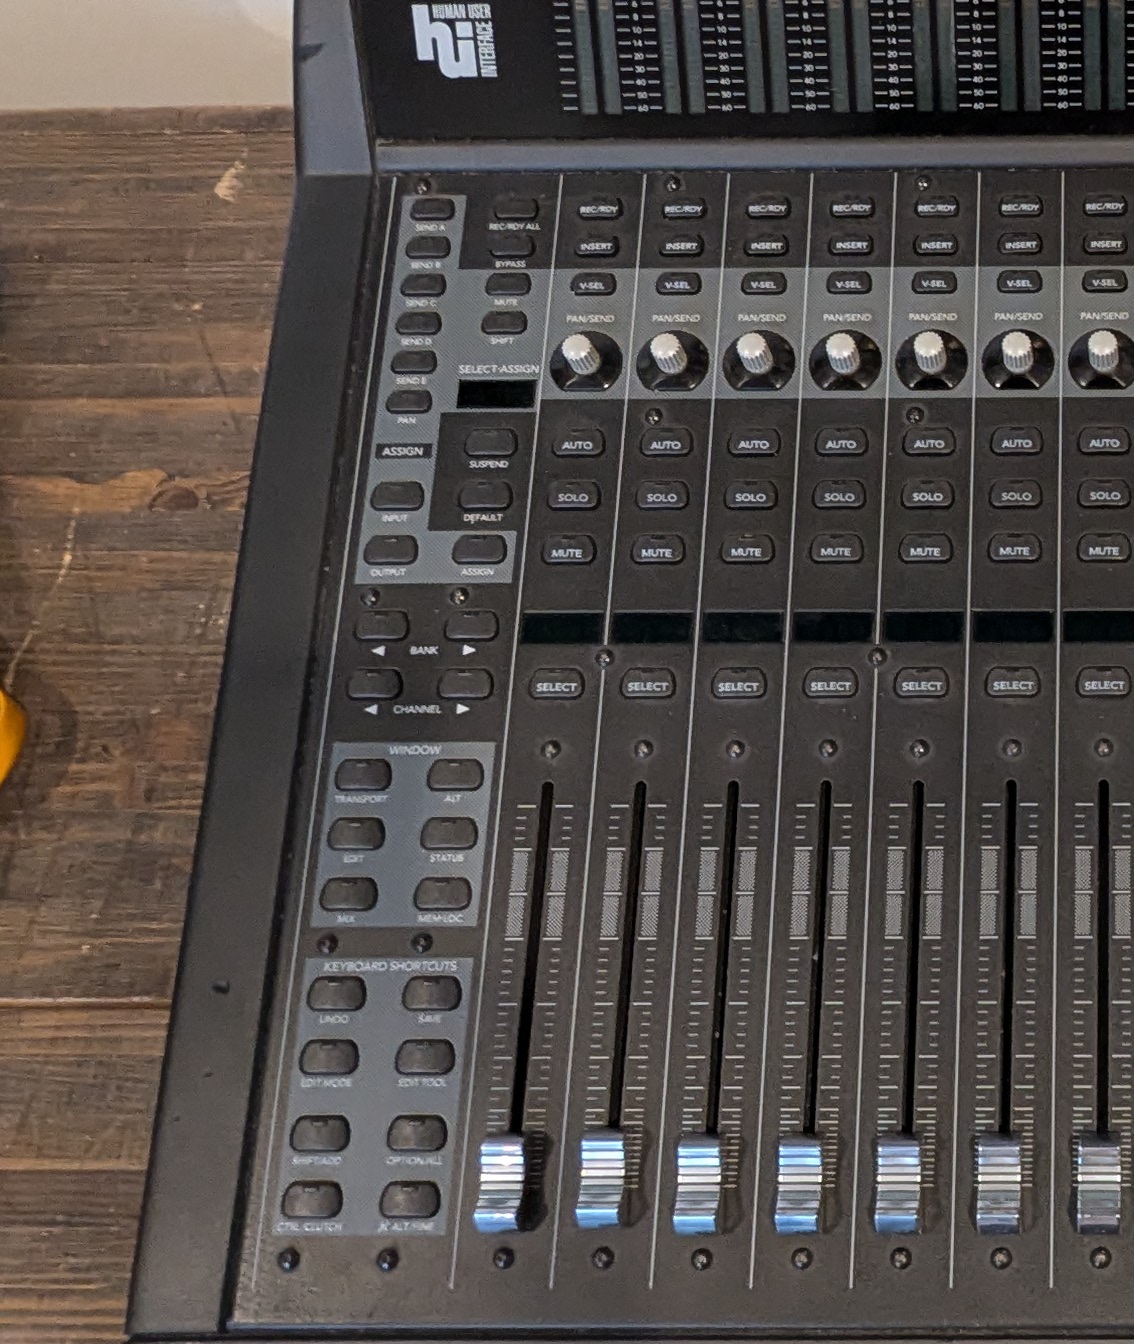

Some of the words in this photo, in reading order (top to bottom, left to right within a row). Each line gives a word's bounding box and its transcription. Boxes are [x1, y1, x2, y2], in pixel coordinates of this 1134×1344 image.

[432, 5, 466, 19] HUMAN
[468, 4, 491, 18] USER
[666, 242, 698, 250] INSERT
[665, 281, 690, 289] V-SEL
[1007, 279, 1032, 287] V-SEL
[738, 314, 786, 322] PAN/SEND
[562, 441, 592, 449] AUTO
[651, 441, 681, 449] AUTO
[826, 440, 856, 448] AUTO
[915, 440, 945, 448] AUTO
[1090, 439, 1120, 447] AUTO
[383, 447, 423, 455] ASSIGN
[469, 460, 508, 468] SUSPEND
[558, 494, 588, 502] SOLO
[647, 494, 677, 502] SOLO
[825, 493, 855, 501] SOLO
[912, 493, 943, 501] SOLO
[1090, 492, 1121, 500] SOLO
[463, 514, 504, 522] DEFAULT
[552, 549, 582, 557] MUTE
[642, 549, 672, 557] MUTE
[821, 548, 851, 556] MUTE
[1090, 547, 1119, 555] MUTE
[409, 646, 438, 655] BANK
[537, 683, 577, 691] SELECT
[628, 682, 668, 691] SELECT
[811, 682, 851, 690] SELECT
[902, 681, 942, 691] SELECT
[1085, 681, 1125, 690] SELECT
[393, 705, 442, 714] CHANNEL
